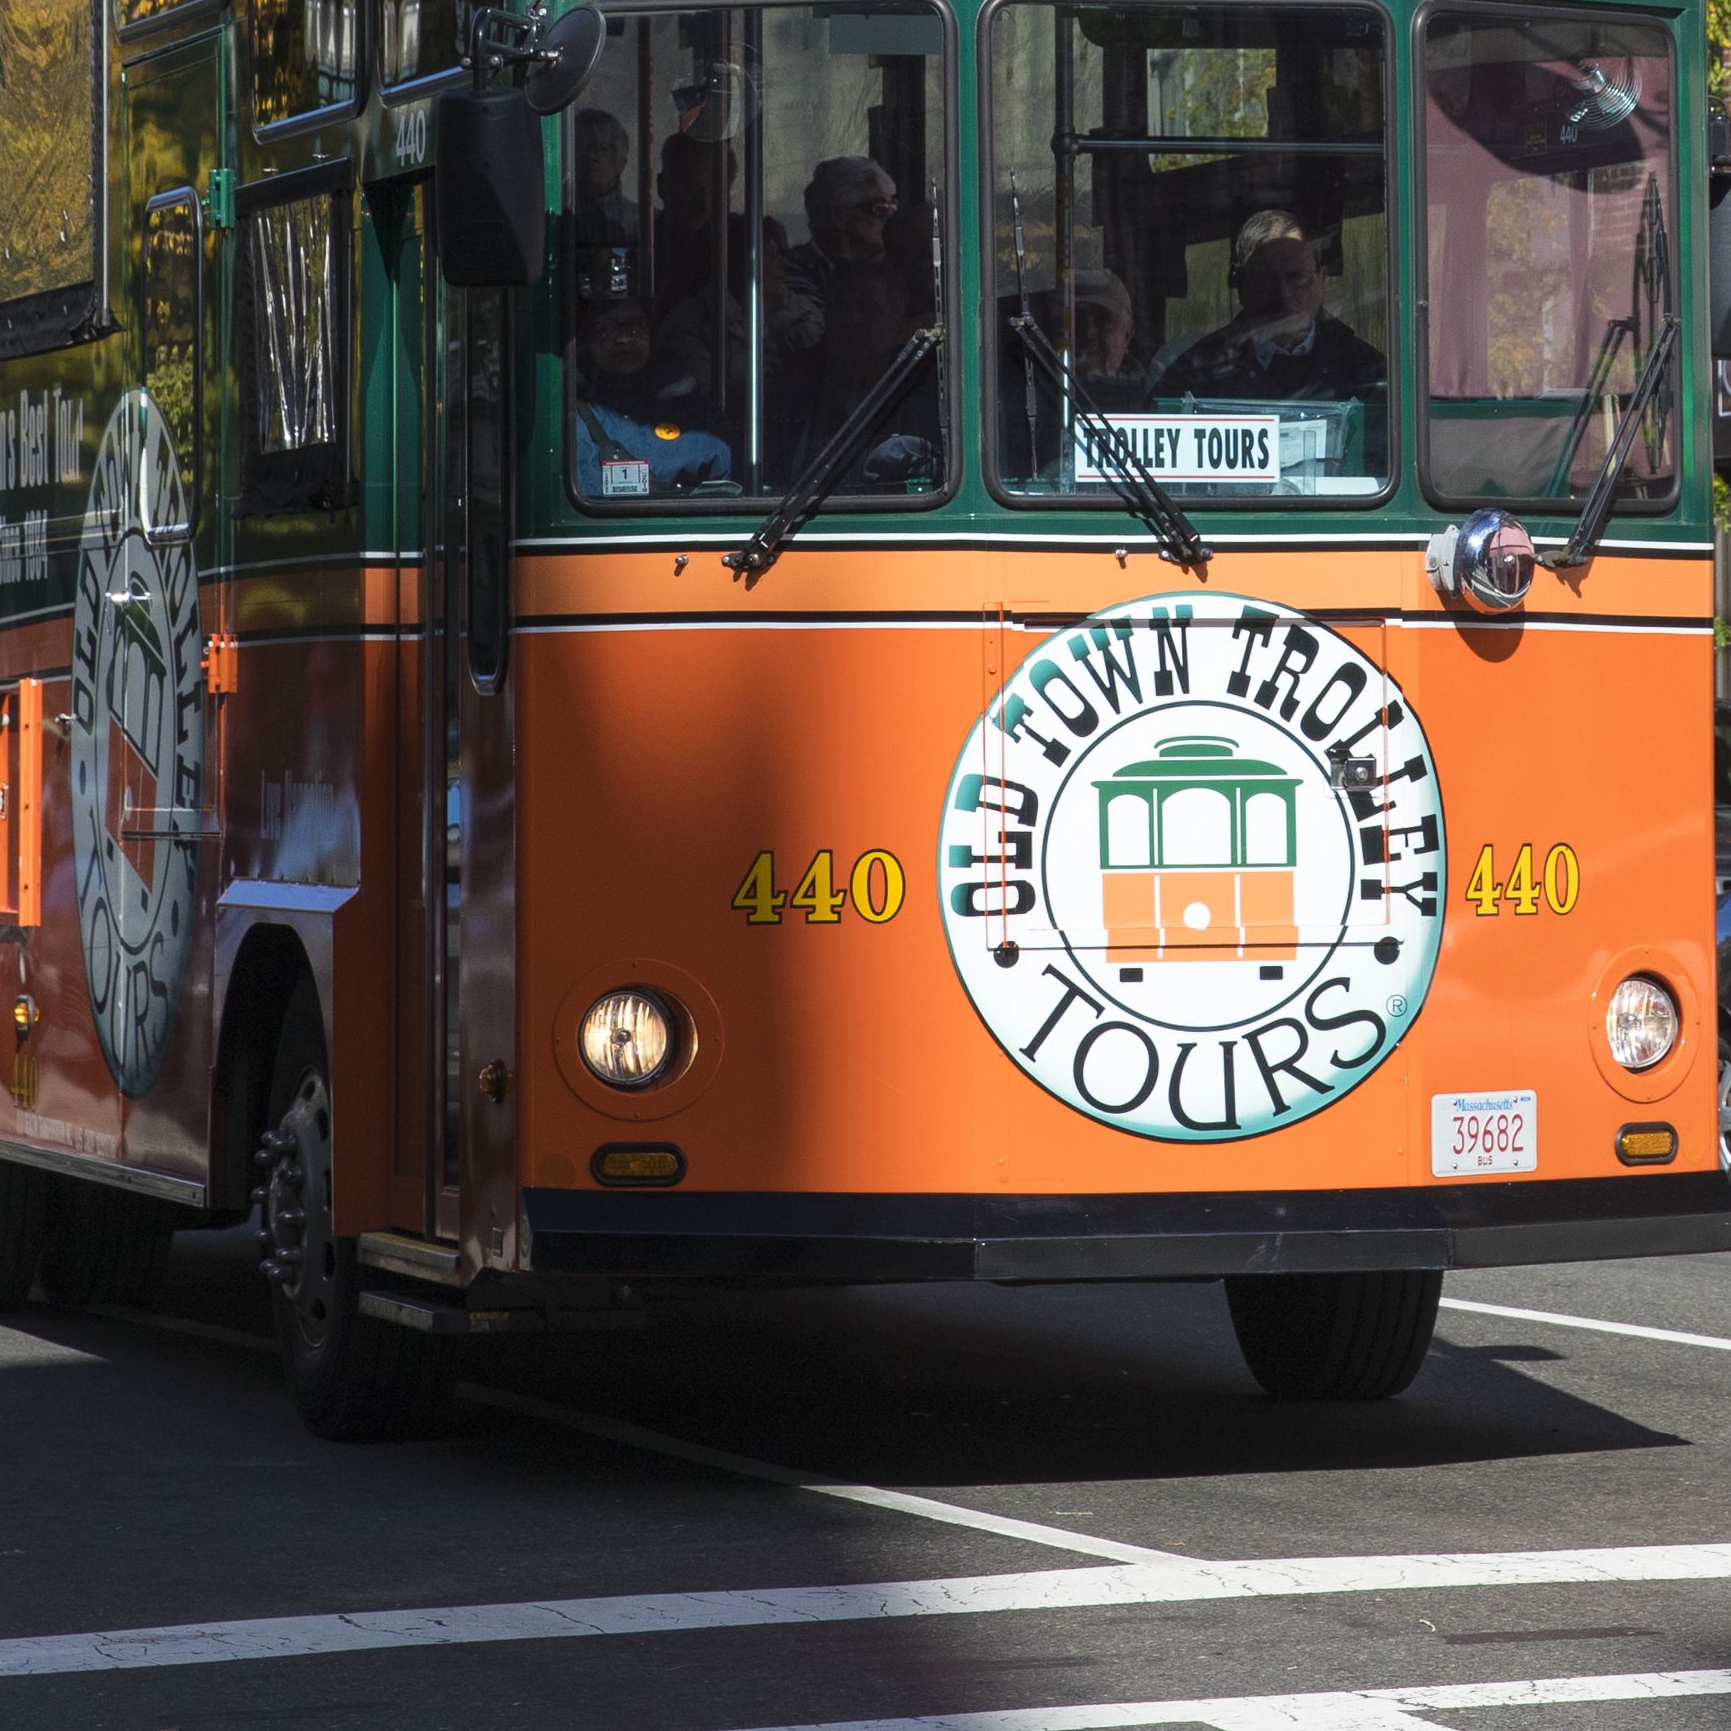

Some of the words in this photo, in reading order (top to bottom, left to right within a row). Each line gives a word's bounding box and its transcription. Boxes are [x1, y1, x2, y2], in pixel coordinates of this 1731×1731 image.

[396, 109, 426, 167] 440
[19, 388, 50, 489] Best
[1083, 427, 1181, 470] TROLLEY
[1193, 427, 1269, 470] TOURS
[73, 546, 101, 736] OLD
[991, 603, 1194, 768] TOWN
[1225, 604, 1441, 918] TROLLEY
[731, 847, 907, 926] 440
[948, 772, 1039, 919] OLD
[1465, 842, 1581, 917] 440
[79, 807, 169, 1081] TOURS
[1018, 962, 1388, 1132] TOURS
[1452, 1113, 1524, 1155] 39682
[1456, 1097, 1514, 1112] Massachusetts
[1477, 1155, 1493, 1166] BUS
